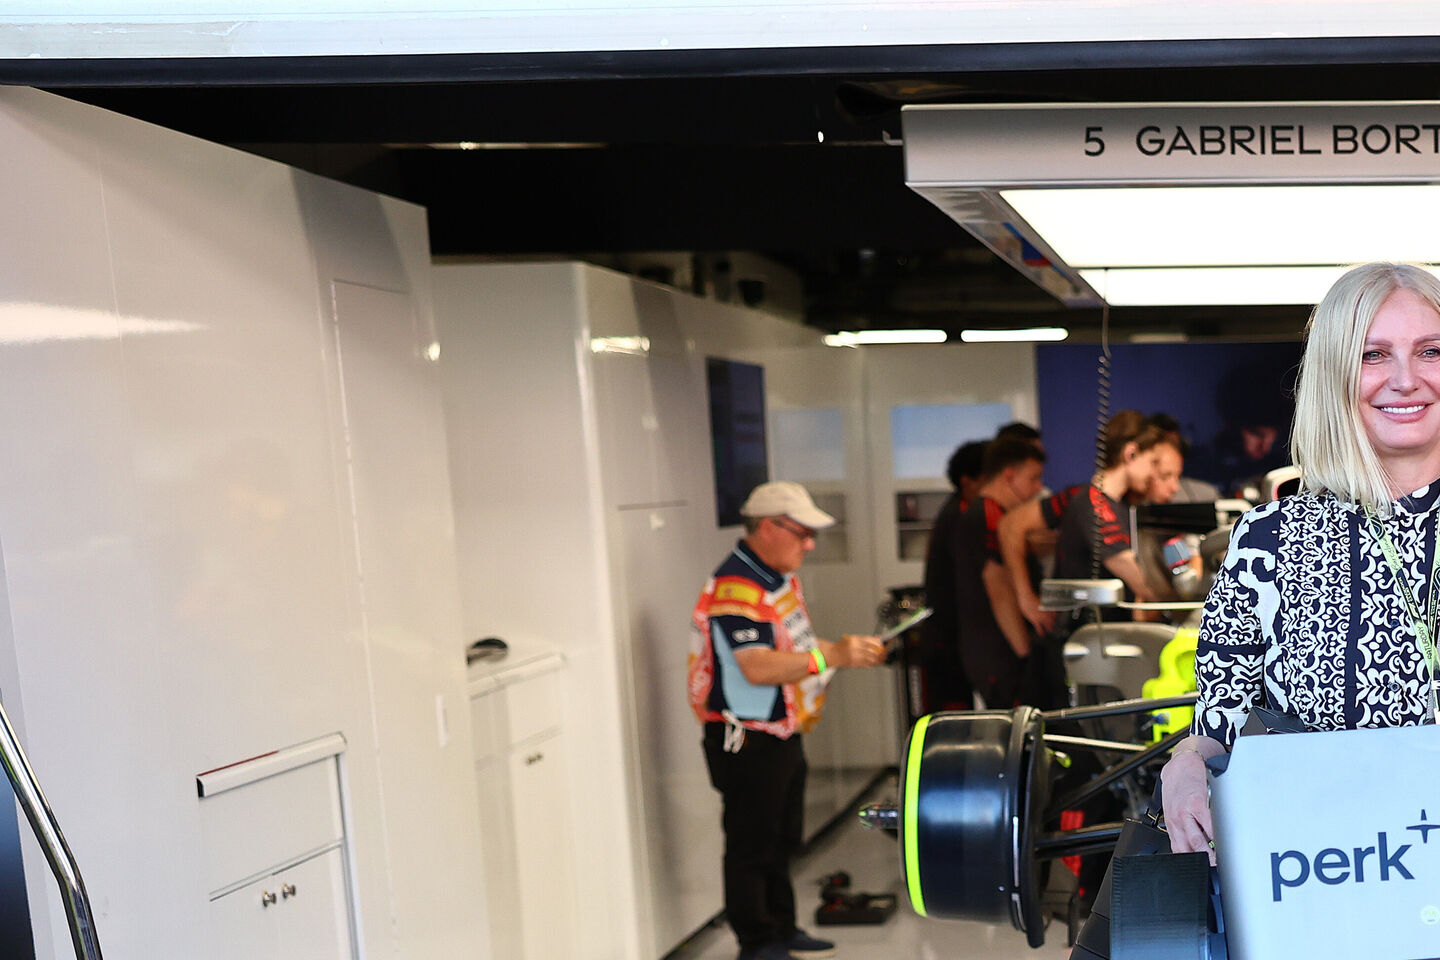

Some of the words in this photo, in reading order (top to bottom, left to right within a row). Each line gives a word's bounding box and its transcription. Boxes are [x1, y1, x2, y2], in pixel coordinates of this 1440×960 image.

[1084, 126, 1105, 157] 5
[1136, 125, 1322, 156] GABRIEL
[1416, 625, 1433, 660] SATURDAY
